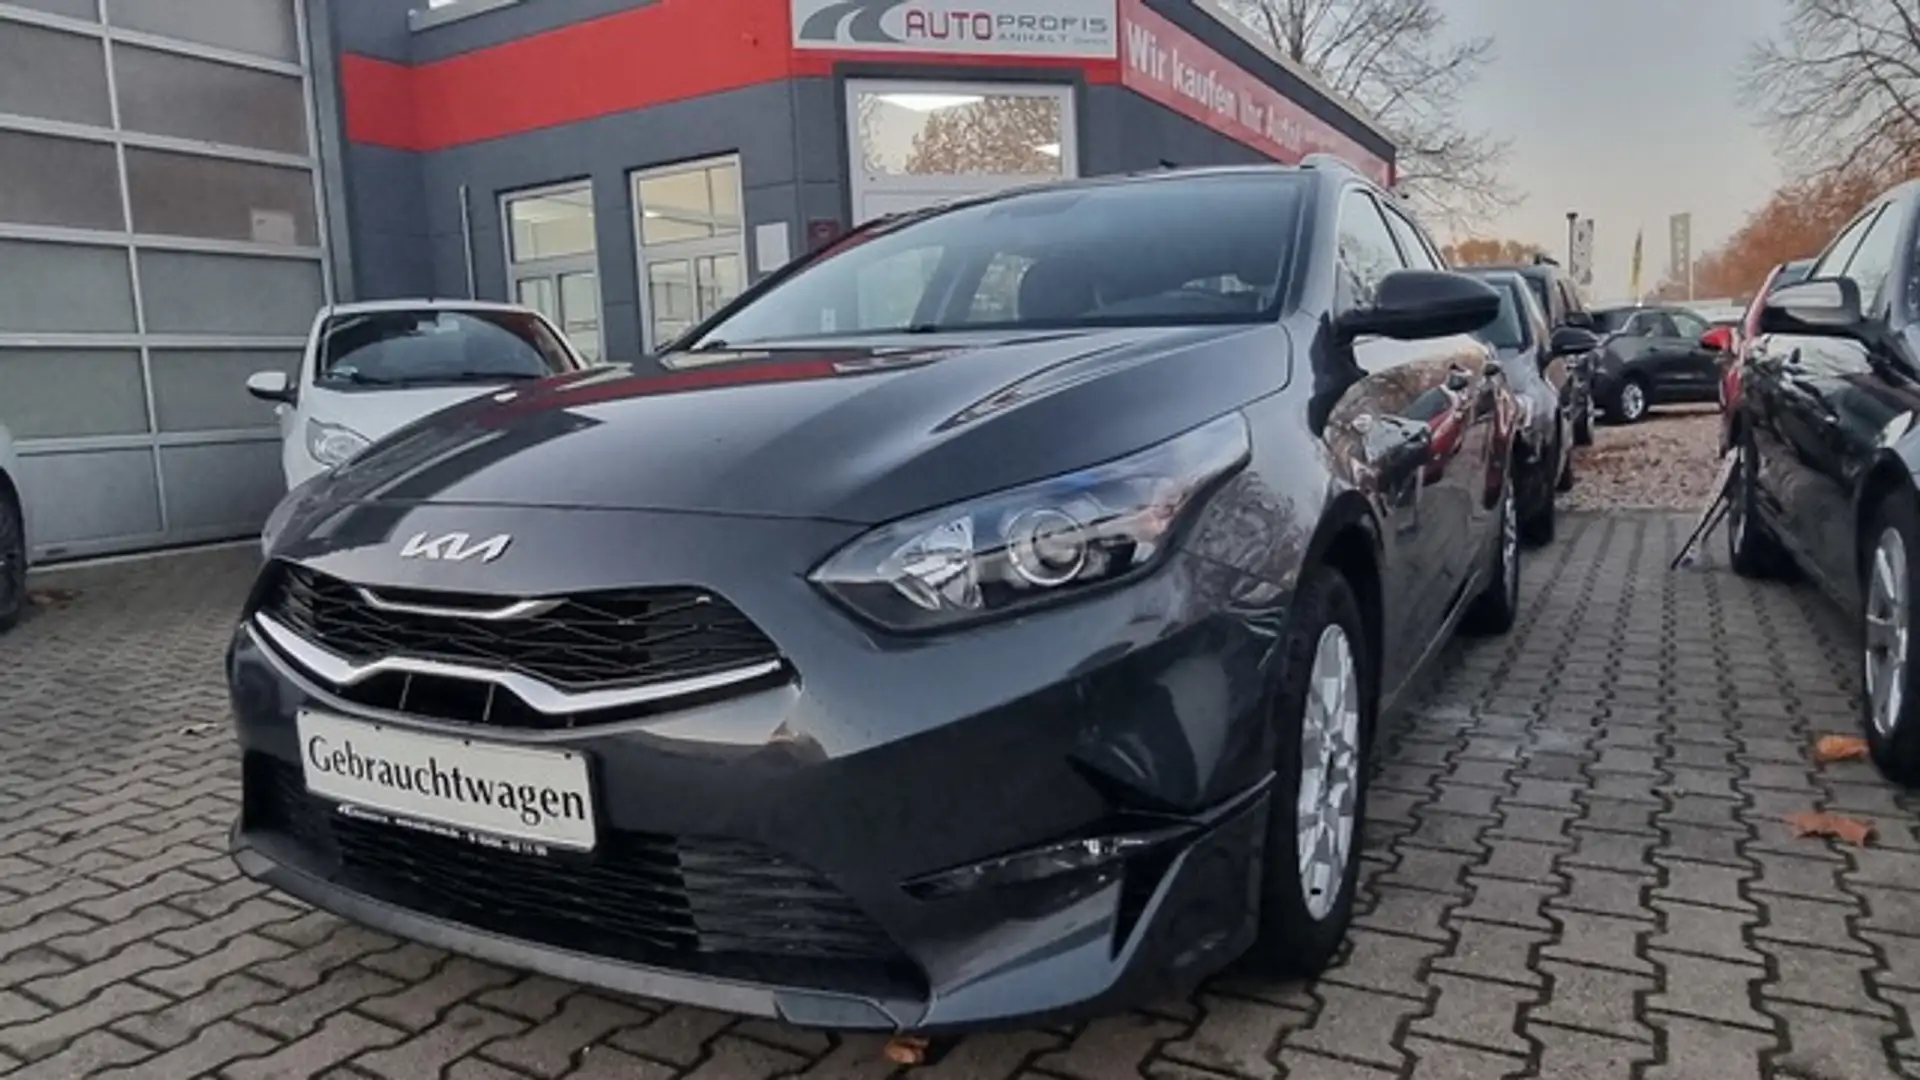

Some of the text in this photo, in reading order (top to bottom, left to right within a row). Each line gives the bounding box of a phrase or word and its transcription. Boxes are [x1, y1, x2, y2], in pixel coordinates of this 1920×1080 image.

[1126, 20, 1169, 83] Wir
[1172, 48, 1237, 120] kaufen
[400, 531, 512, 562] KIA
[308, 735, 585, 826] Gebrauchtwagen
